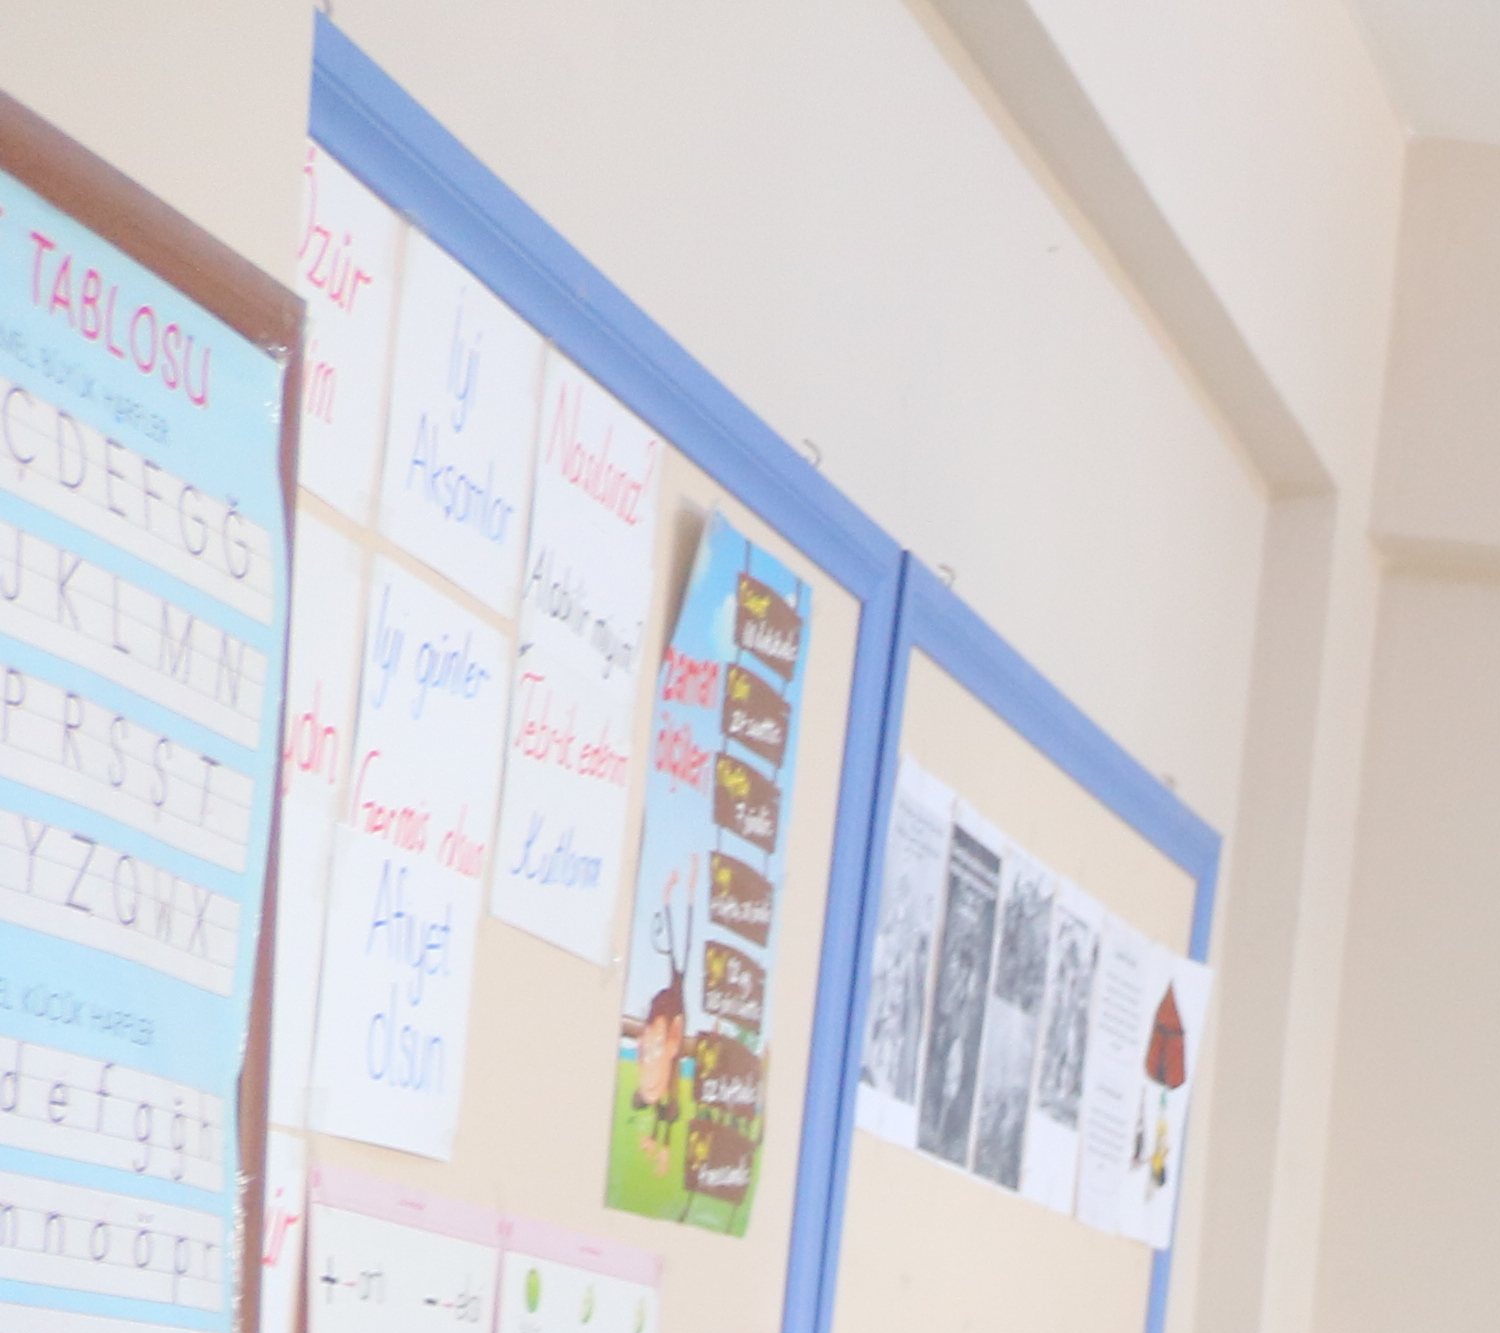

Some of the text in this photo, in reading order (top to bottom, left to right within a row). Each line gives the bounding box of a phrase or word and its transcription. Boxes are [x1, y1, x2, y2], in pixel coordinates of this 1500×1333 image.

[30, 228, 212, 408] TABLOSU
[3, 385, 251, 580] Ç D E F G Ğ
[56, 548, 83, 632] K
[112, 577, 131, 656] L
[157, 602, 193, 676] M
[215, 631, 246, 708] N
[3, 668, 26, 743] P
[62, 692, 84, 773] R
[108, 715, 127, 788] S
[200, 754, 221, 826] T
[20, 816, 52, 894] Y
[65, 833, 97, 913] Z
[365, 858, 453, 1006] Afiyet
[365, 980, 446, 1096] olsun
[48, 1082, 69, 1124] e
[95, 1061, 115, 1134] f
[133, 1103, 152, 1174] g
[44, 1211, 65, 1257] n
[89, 1221, 109, 1263] o
